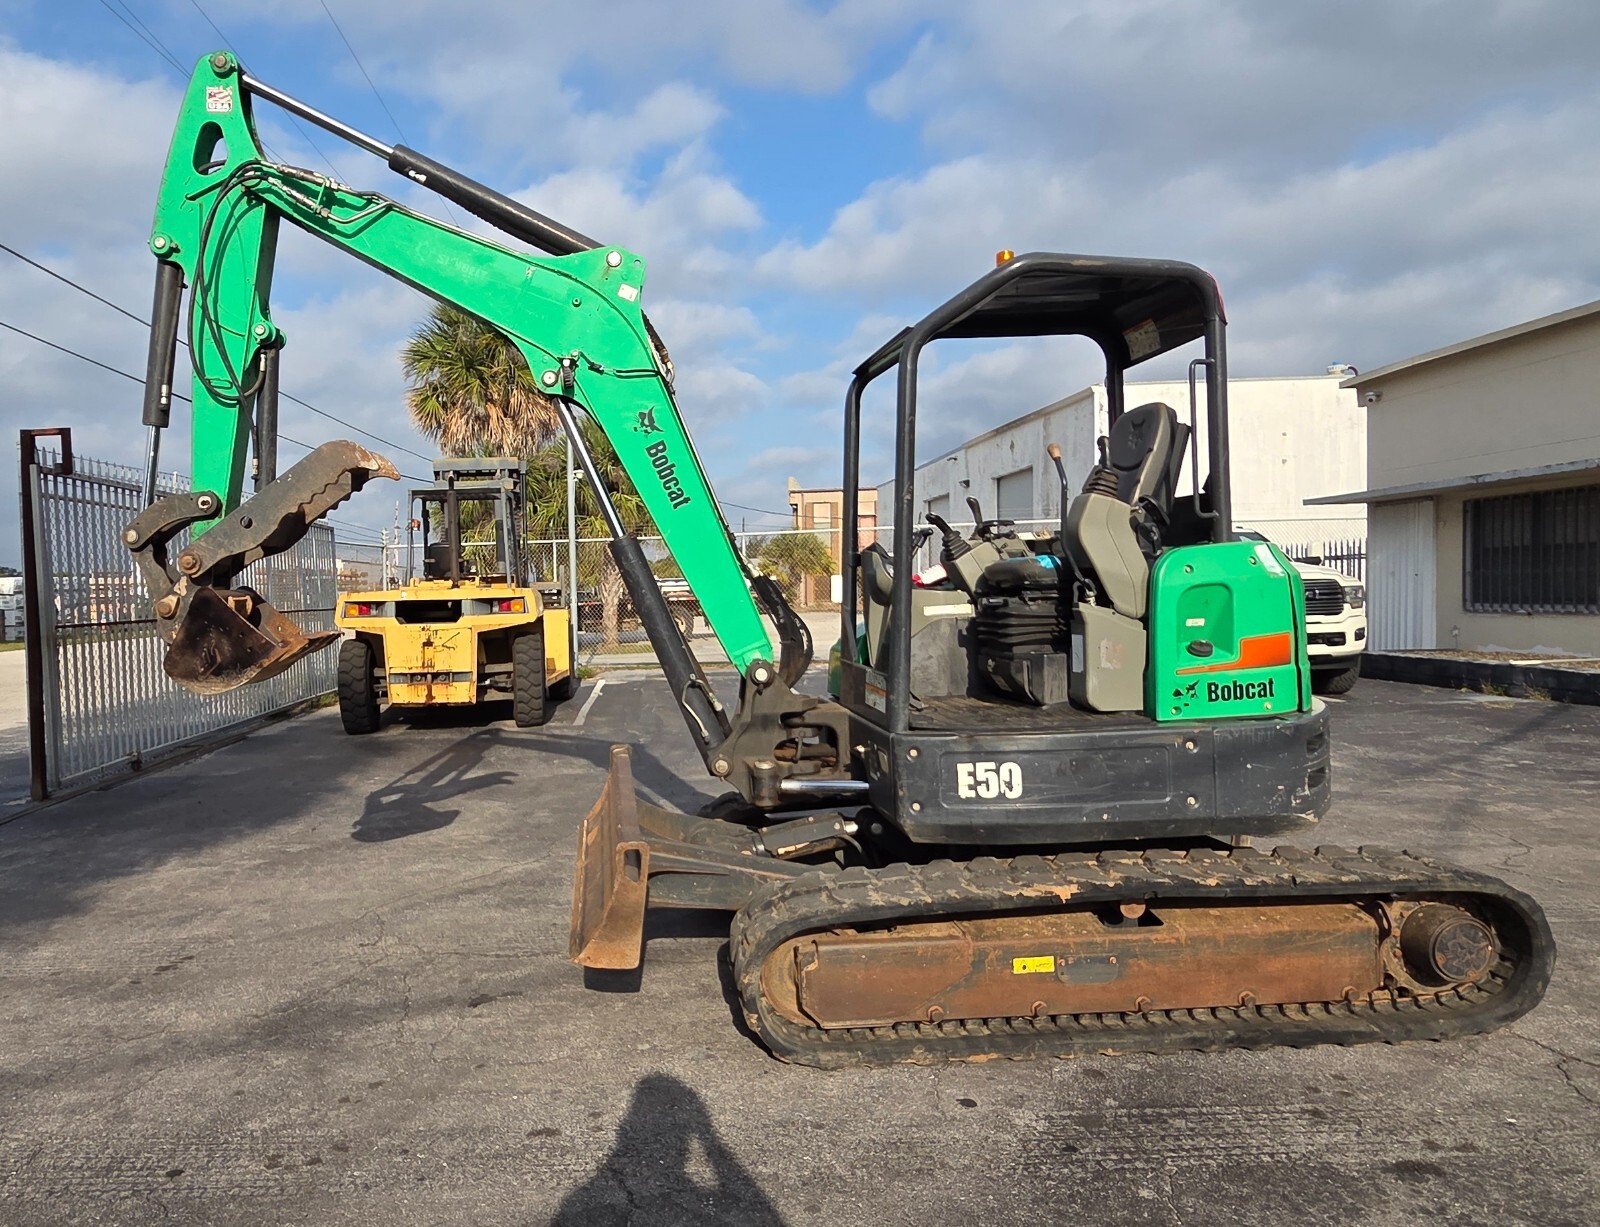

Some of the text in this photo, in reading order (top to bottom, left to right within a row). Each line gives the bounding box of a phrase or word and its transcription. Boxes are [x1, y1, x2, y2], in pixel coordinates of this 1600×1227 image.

[645, 440, 691, 510] Bobcat
[1207, 678, 1275, 702] Bobcat
[956, 761, 1023, 799] E50
